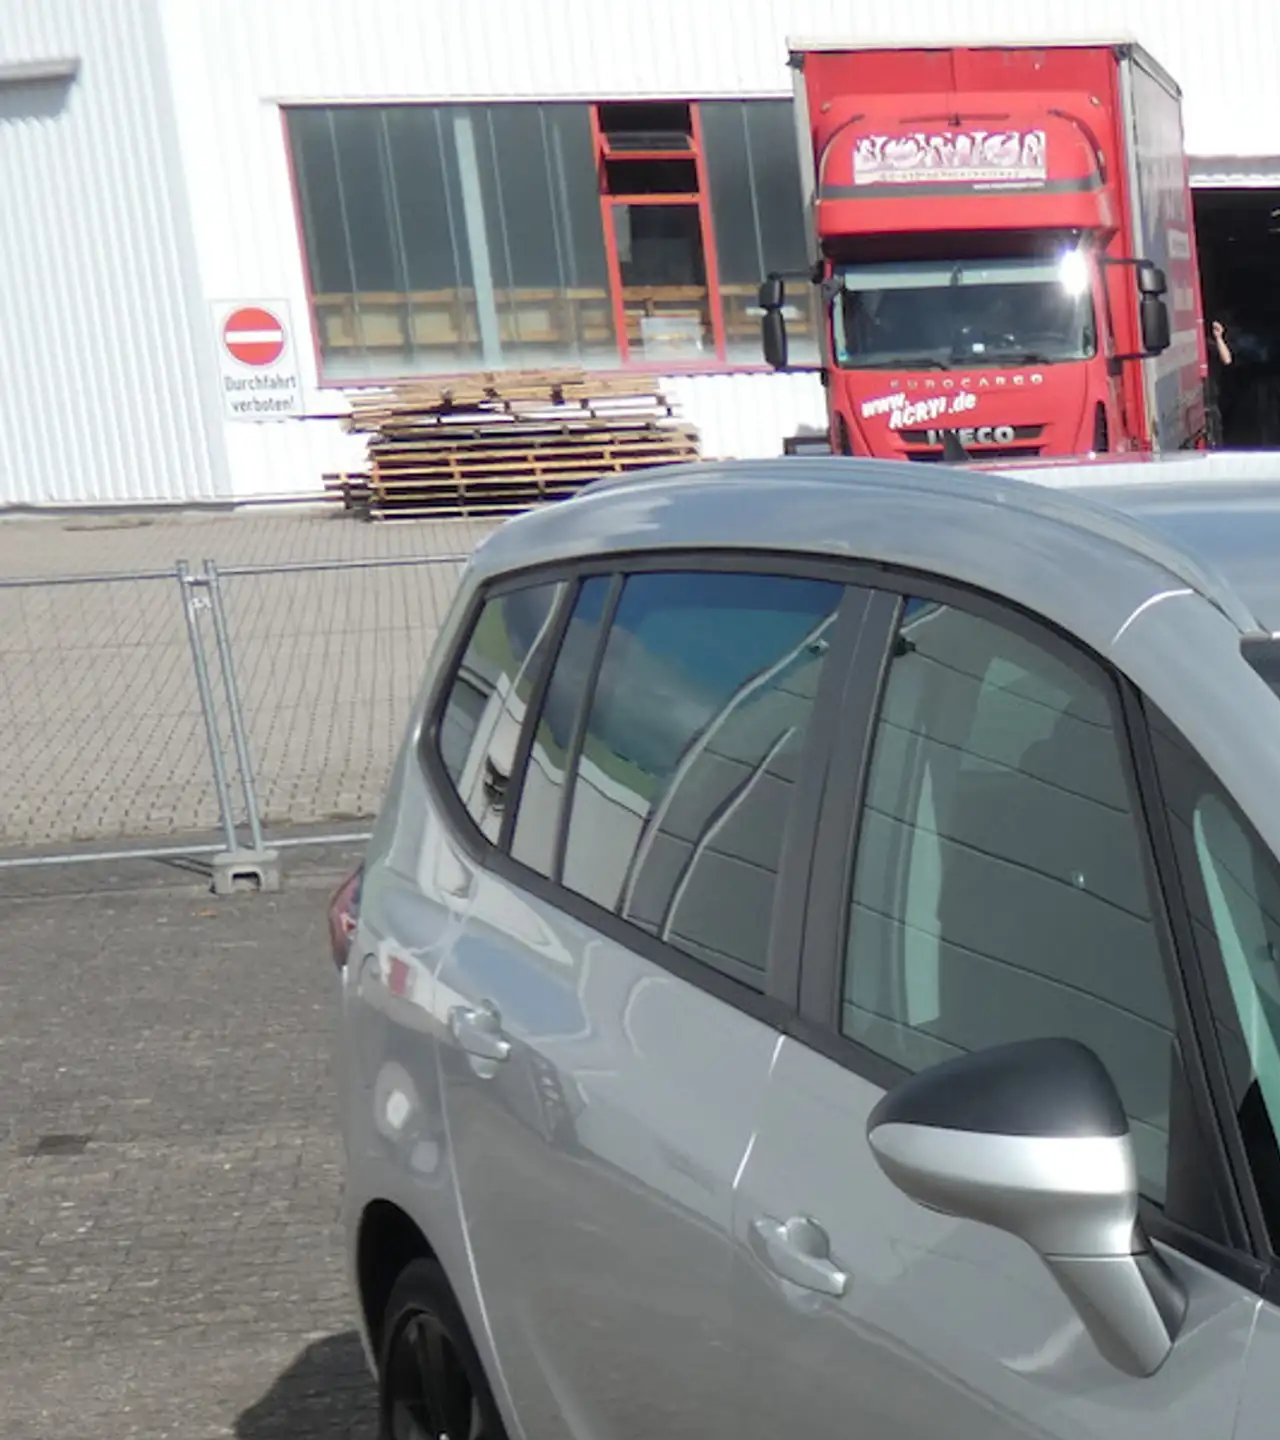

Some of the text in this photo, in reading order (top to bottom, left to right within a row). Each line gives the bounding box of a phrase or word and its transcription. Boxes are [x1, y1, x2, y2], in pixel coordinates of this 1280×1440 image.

[224, 373, 296, 391] Durchfahrt
[890, 374, 1044, 389] EUROCARGO
[230, 395, 294, 412] verboten!
